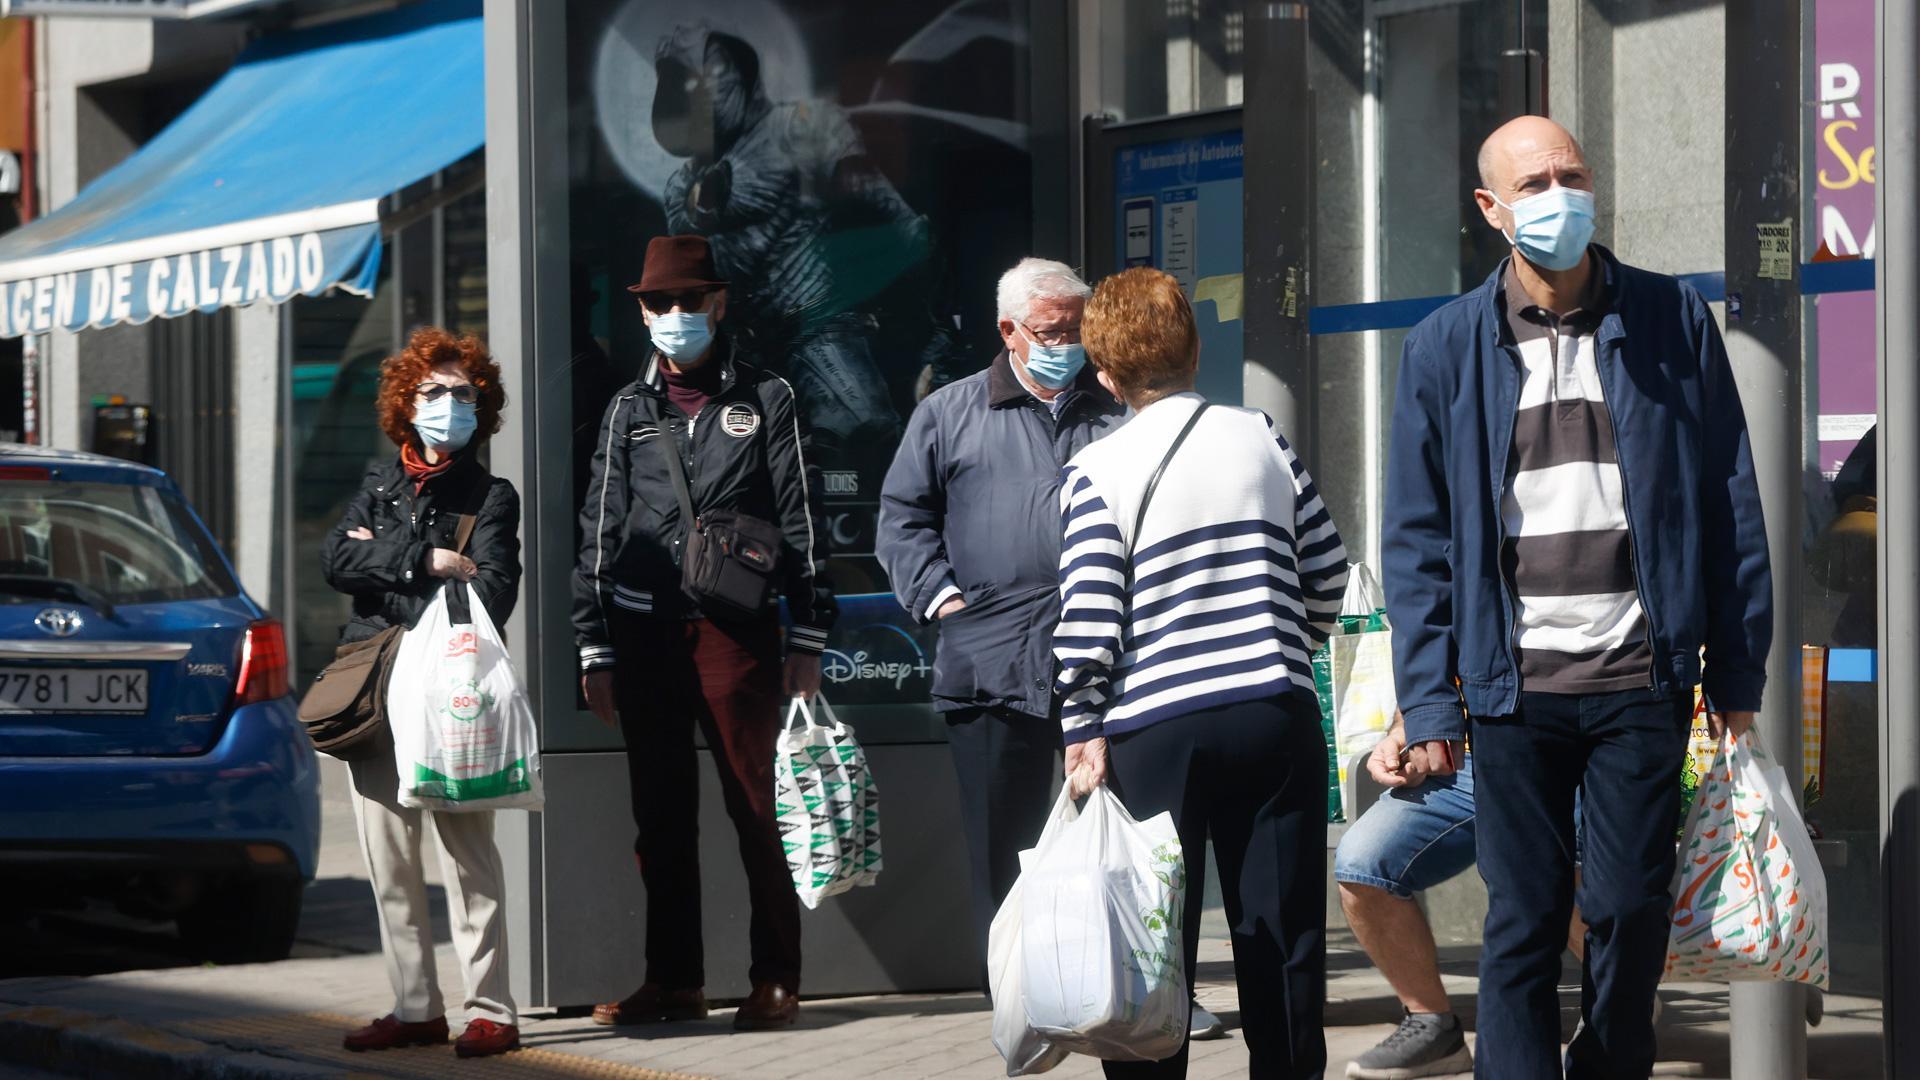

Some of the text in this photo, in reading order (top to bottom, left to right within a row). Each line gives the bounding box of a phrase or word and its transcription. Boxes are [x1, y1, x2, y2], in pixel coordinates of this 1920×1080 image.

[89, 262, 133, 322] DE
[147, 232, 324, 318] CALZADO
[86, 674, 142, 703] JCK
